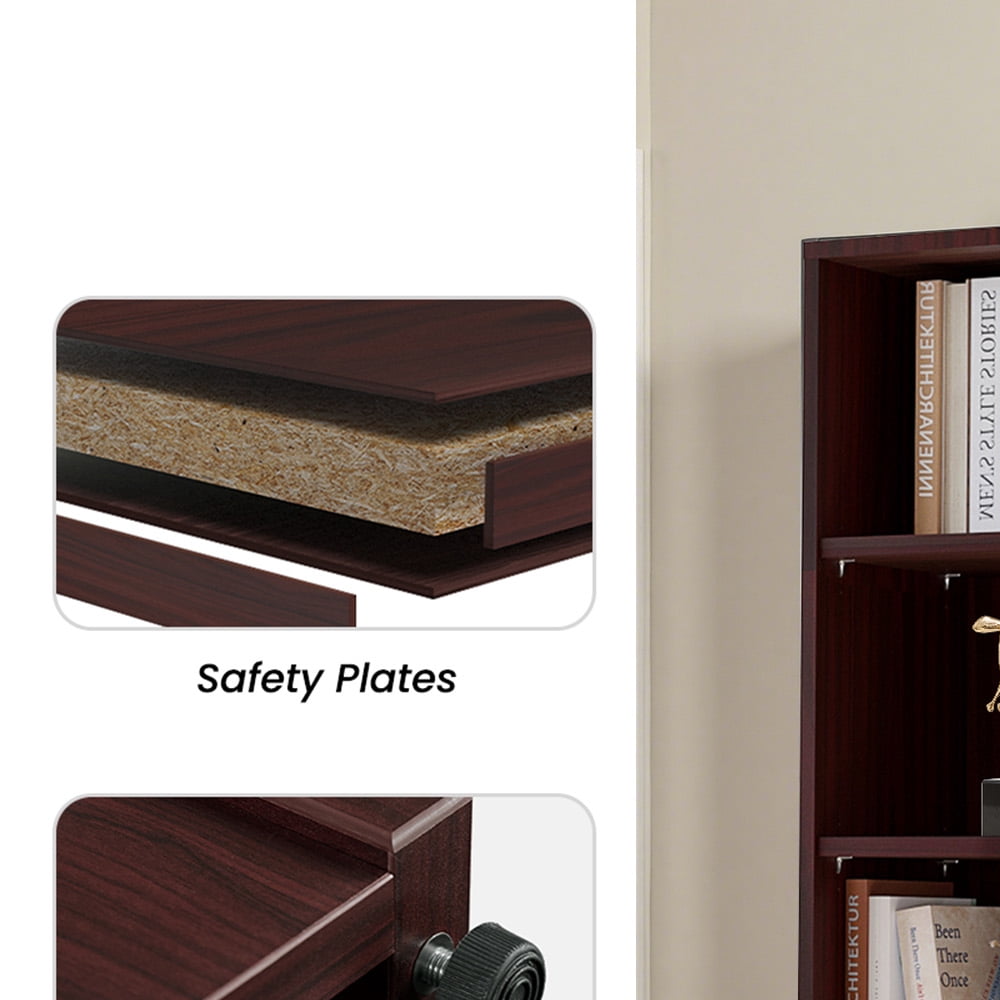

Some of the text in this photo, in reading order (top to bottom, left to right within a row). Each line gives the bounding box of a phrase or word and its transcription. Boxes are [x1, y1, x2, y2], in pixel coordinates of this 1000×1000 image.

[935, 924, 960, 939] Been
[937, 948, 968, 963] There
[940, 972, 969, 987] Once
